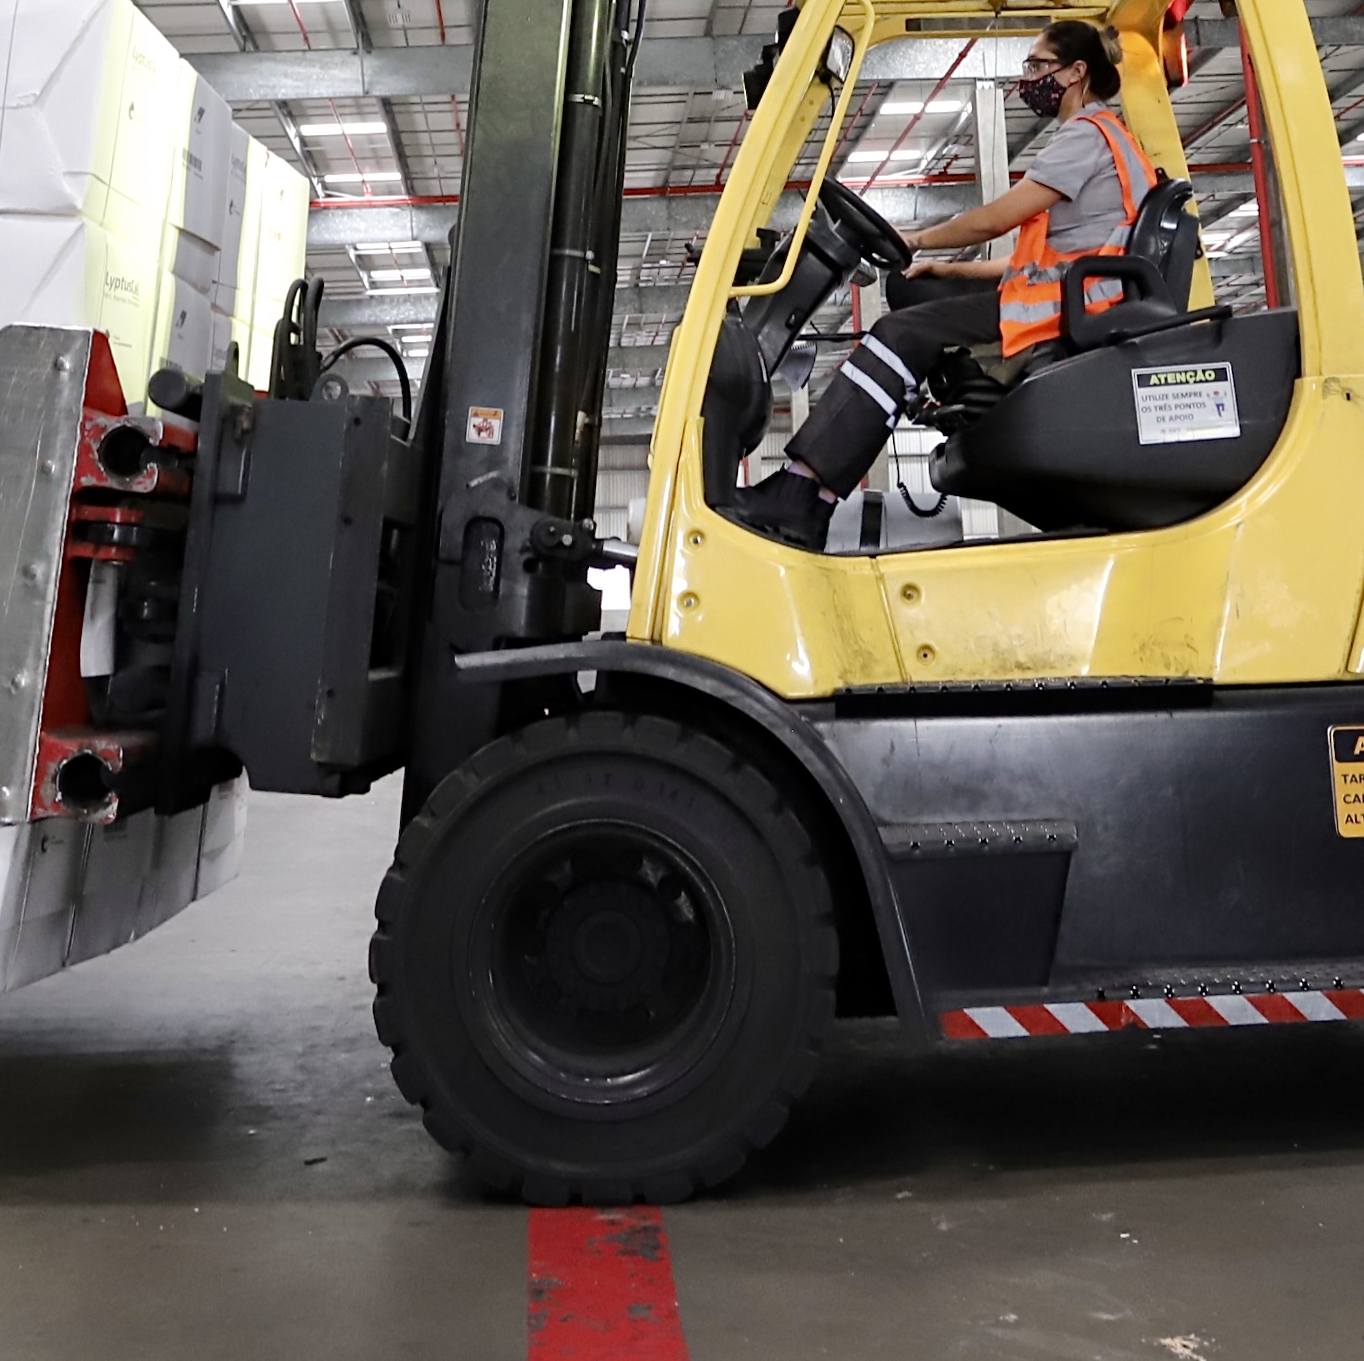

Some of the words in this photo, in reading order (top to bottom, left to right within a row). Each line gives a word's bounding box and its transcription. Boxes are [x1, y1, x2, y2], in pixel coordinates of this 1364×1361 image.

[1149, 369, 1216, 385] ATENÇÃO
[1141, 393, 1169, 402] UTILIZE
[1171, 391, 1203, 400] SEMPRE
[1141, 405, 1152, 413] OS
[1154, 402, 1173, 412] TRÊS
[1174, 401, 1207, 411] PONTOS
[1156, 415, 1166, 423] DE
[1168, 413, 1194, 422] APOIO
